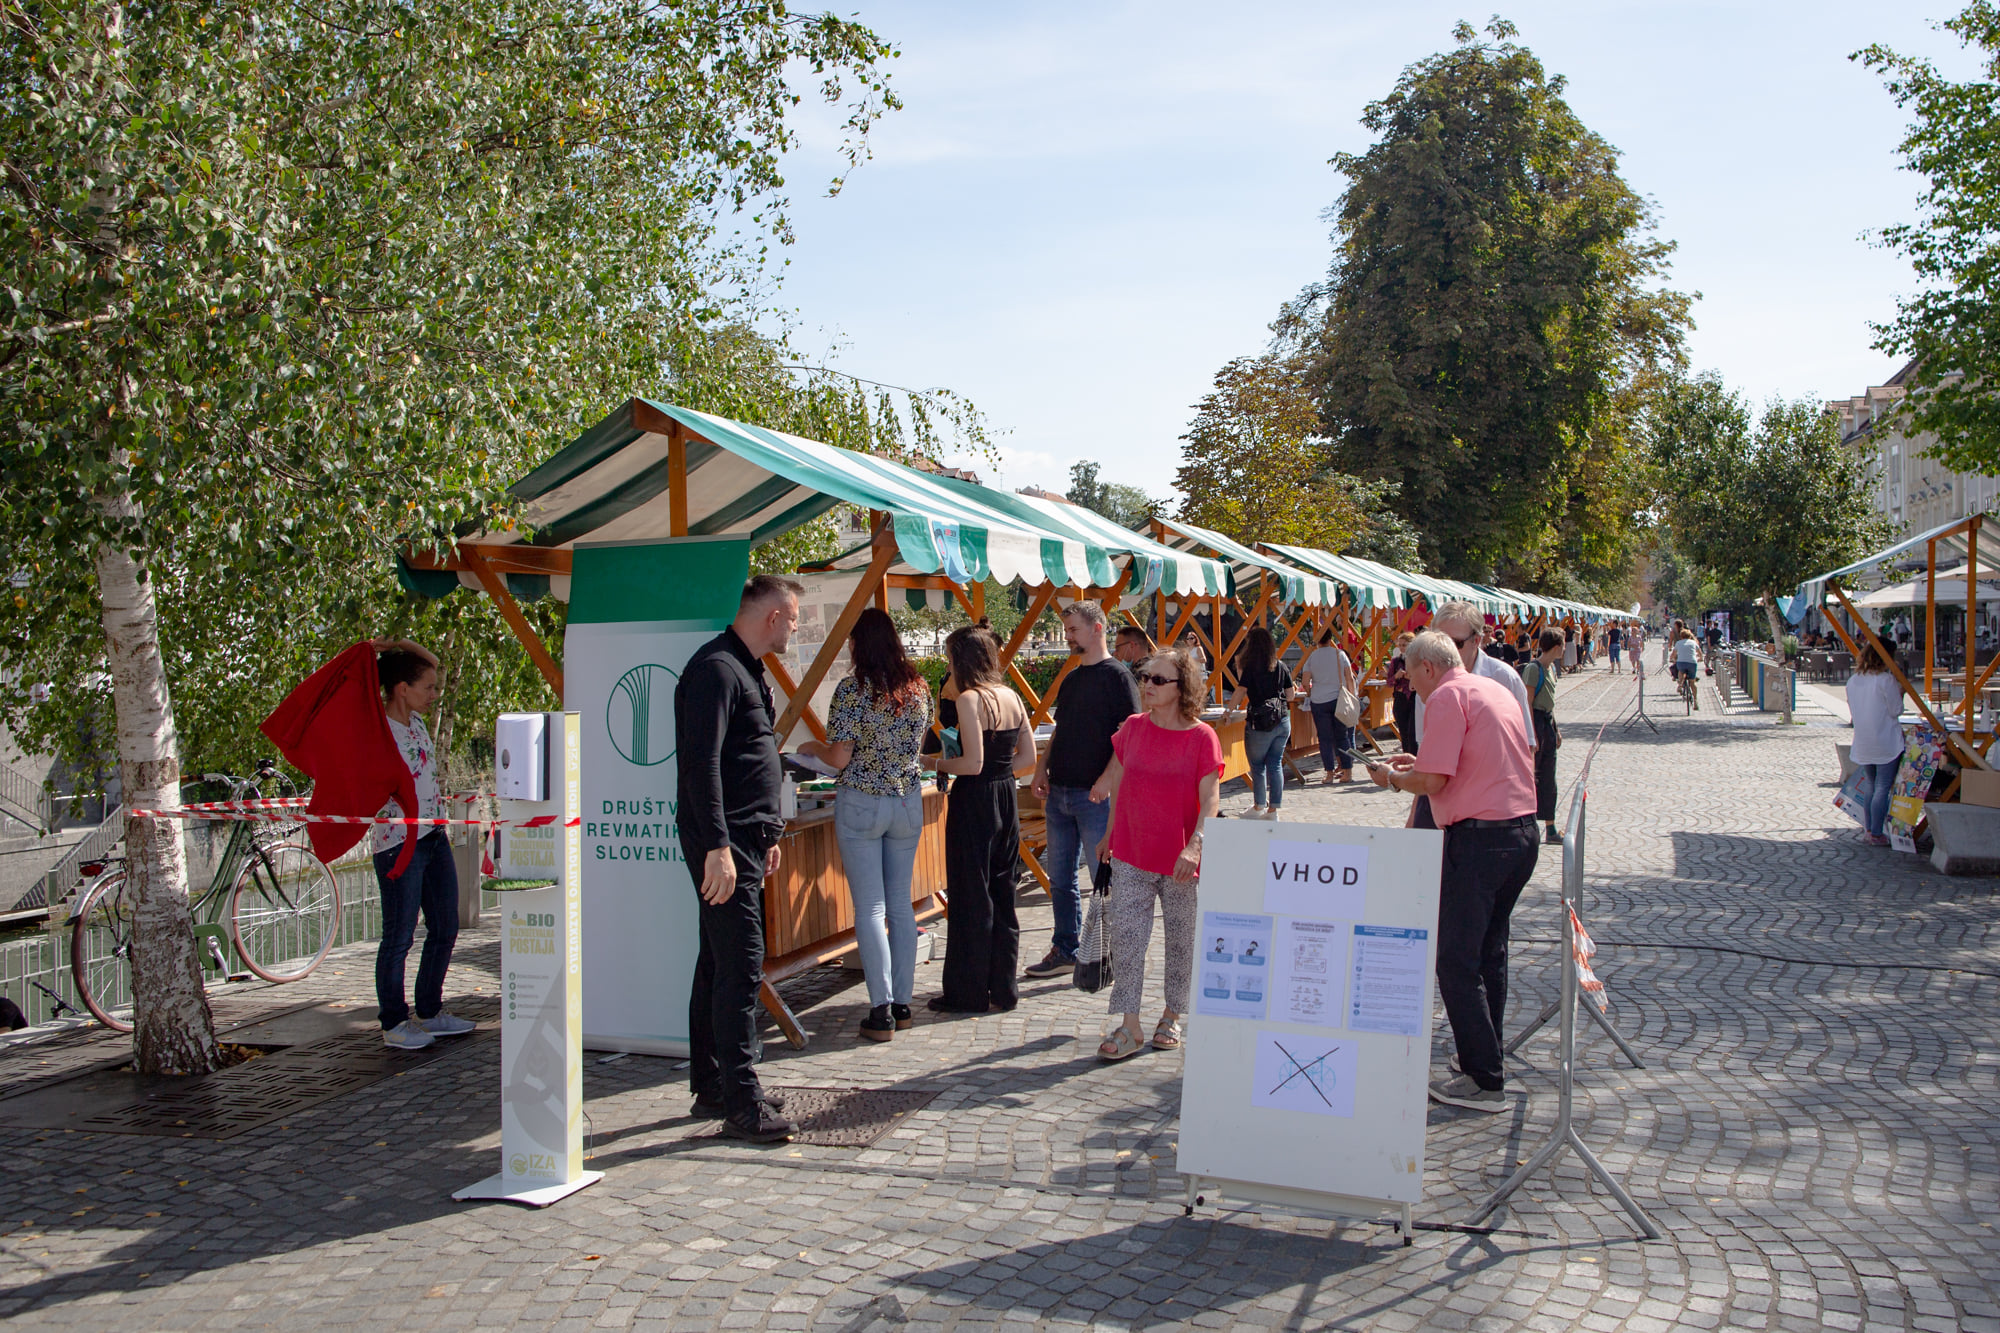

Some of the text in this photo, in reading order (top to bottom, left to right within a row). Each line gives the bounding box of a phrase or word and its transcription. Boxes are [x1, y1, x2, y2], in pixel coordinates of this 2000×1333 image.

[527, 826, 555, 839] BIO
[510, 850, 556, 867] POSTAJA
[1272, 861, 1359, 886] VHOD
[527, 913, 555, 927] BIO
[510, 938, 556, 955] POSTAJA
[529, 1153, 556, 1170] IZA
